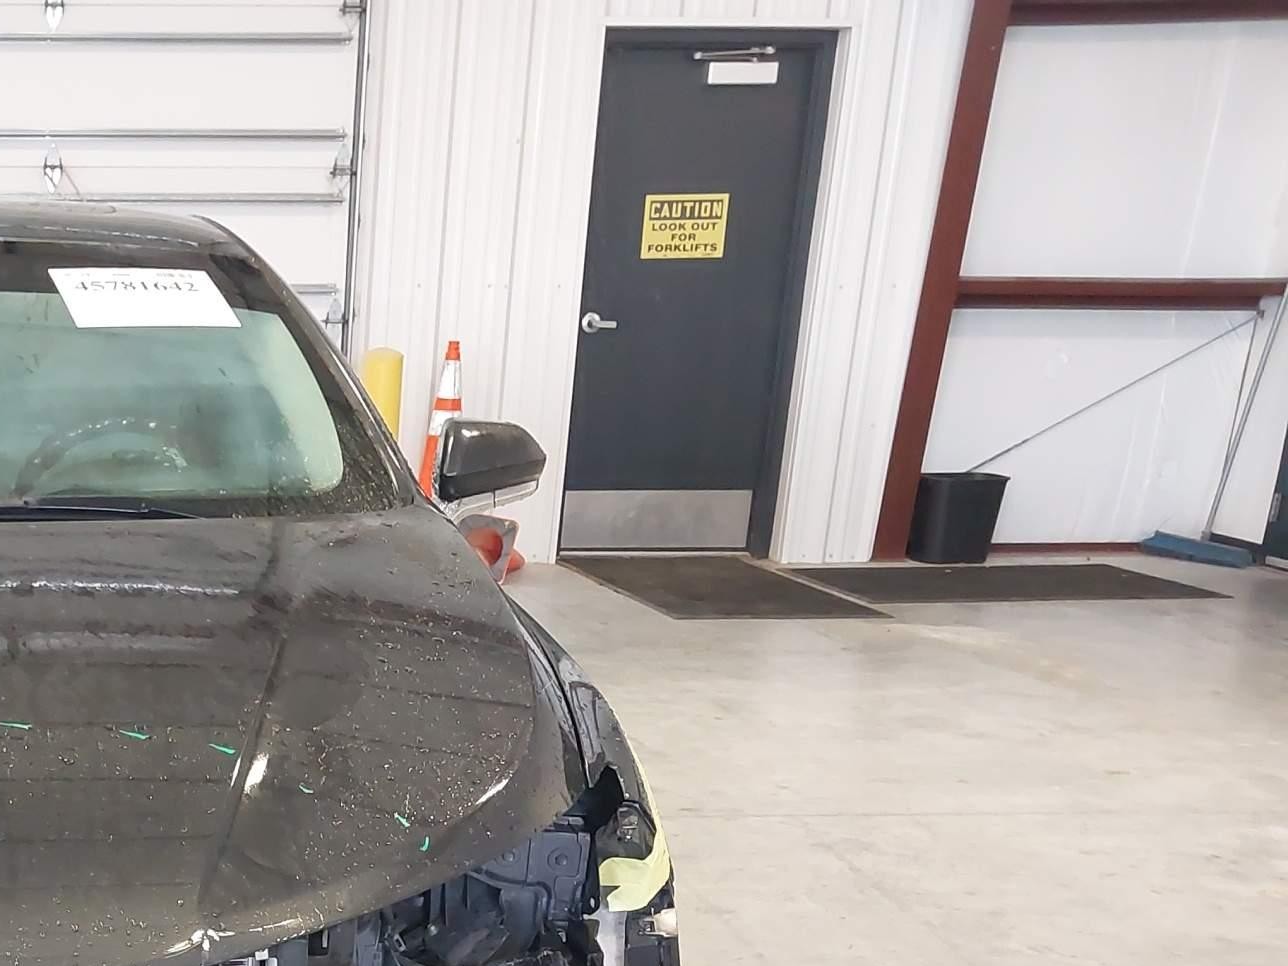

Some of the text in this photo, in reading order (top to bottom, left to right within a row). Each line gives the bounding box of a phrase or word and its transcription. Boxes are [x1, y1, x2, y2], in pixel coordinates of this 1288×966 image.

[650, 201, 723, 218] CAUTION
[652, 222, 718, 231] LOOK OUT
[670, 233, 696, 241] FOR
[647, 243, 718, 253] FORKLIFTS
[74, 280, 201, 292] 45781642
